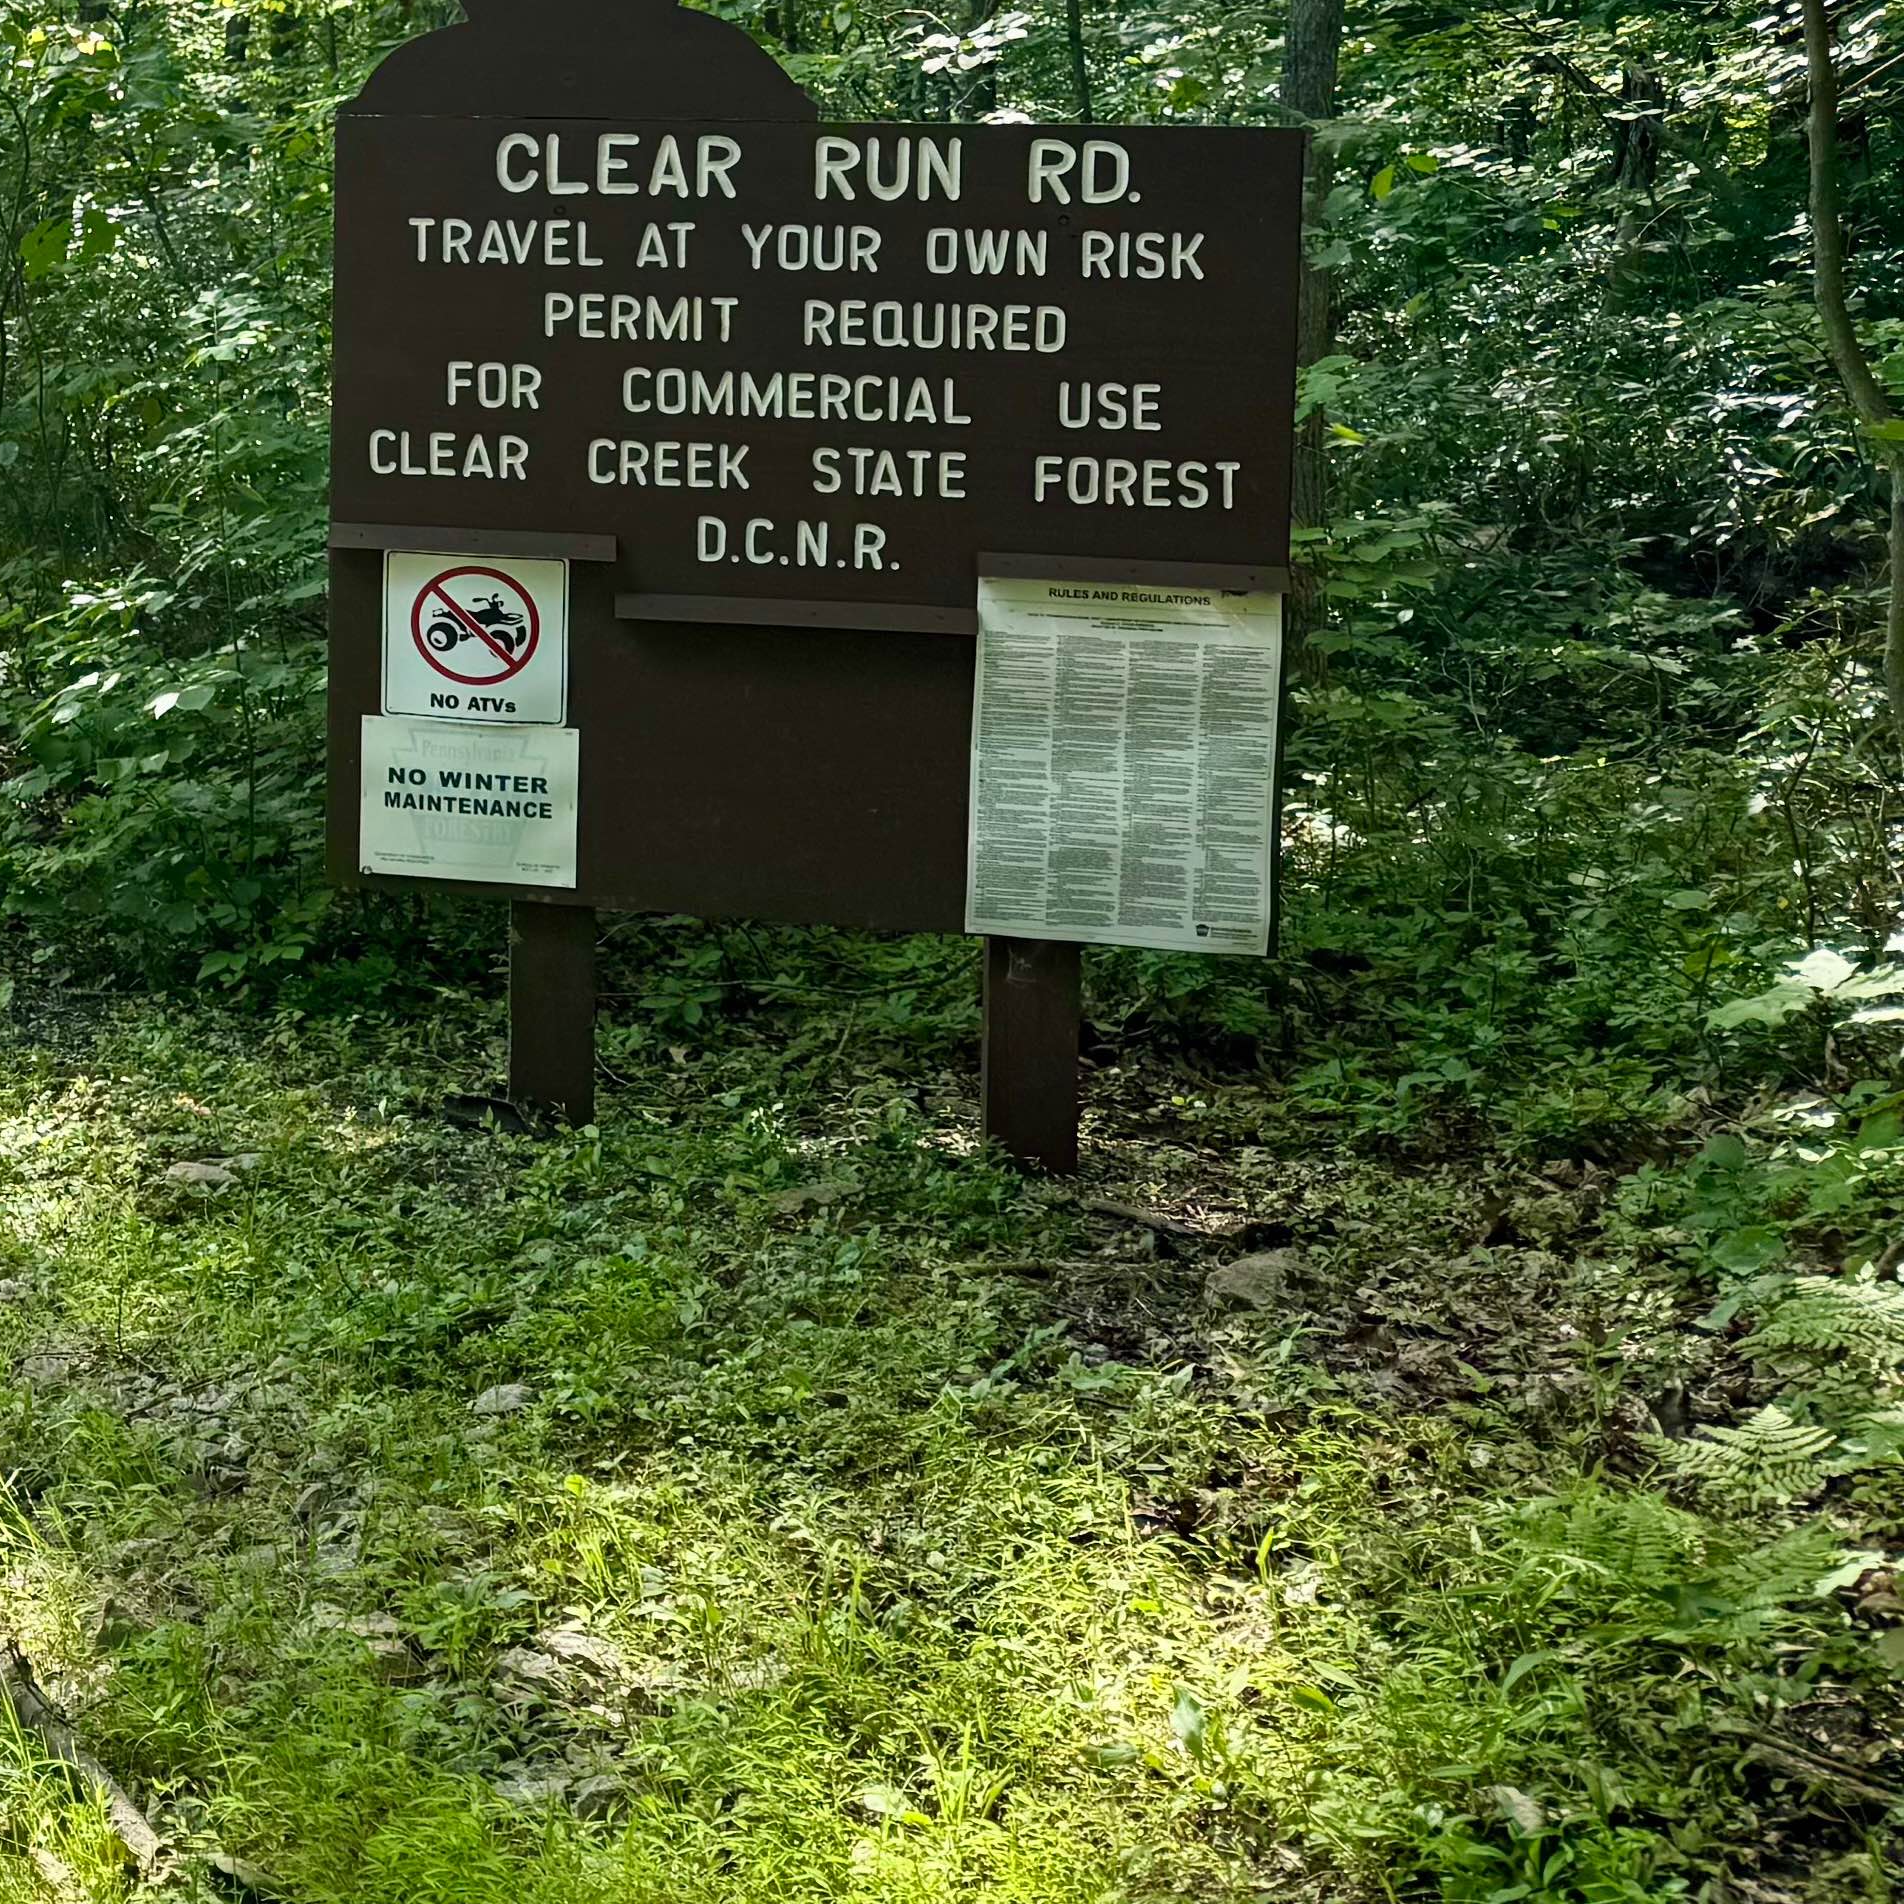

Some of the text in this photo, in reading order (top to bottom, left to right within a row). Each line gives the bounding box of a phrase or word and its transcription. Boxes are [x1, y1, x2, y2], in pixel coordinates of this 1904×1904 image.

[497, 133, 1140, 204] CLEAR RUN RD.
[409, 218, 1204, 280] TRAVEL AT YOUR OWN RISK
[545, 293, 1065, 352] PERMIT REQUIRED
[448, 362, 1161, 430] FOR COMMERCIAL USE
[370, 430, 1240, 509] CLEAR CREEK STATE FOREST
[698, 516, 899, 570] D.C.N.R.
[1049, 588, 1211, 606] RULES AND REGULATIONS
[430, 693, 516, 713] NO ATVs
[385, 792, 552, 819] MAINTENANCE
[388, 767, 548, 794] NO WINTER
